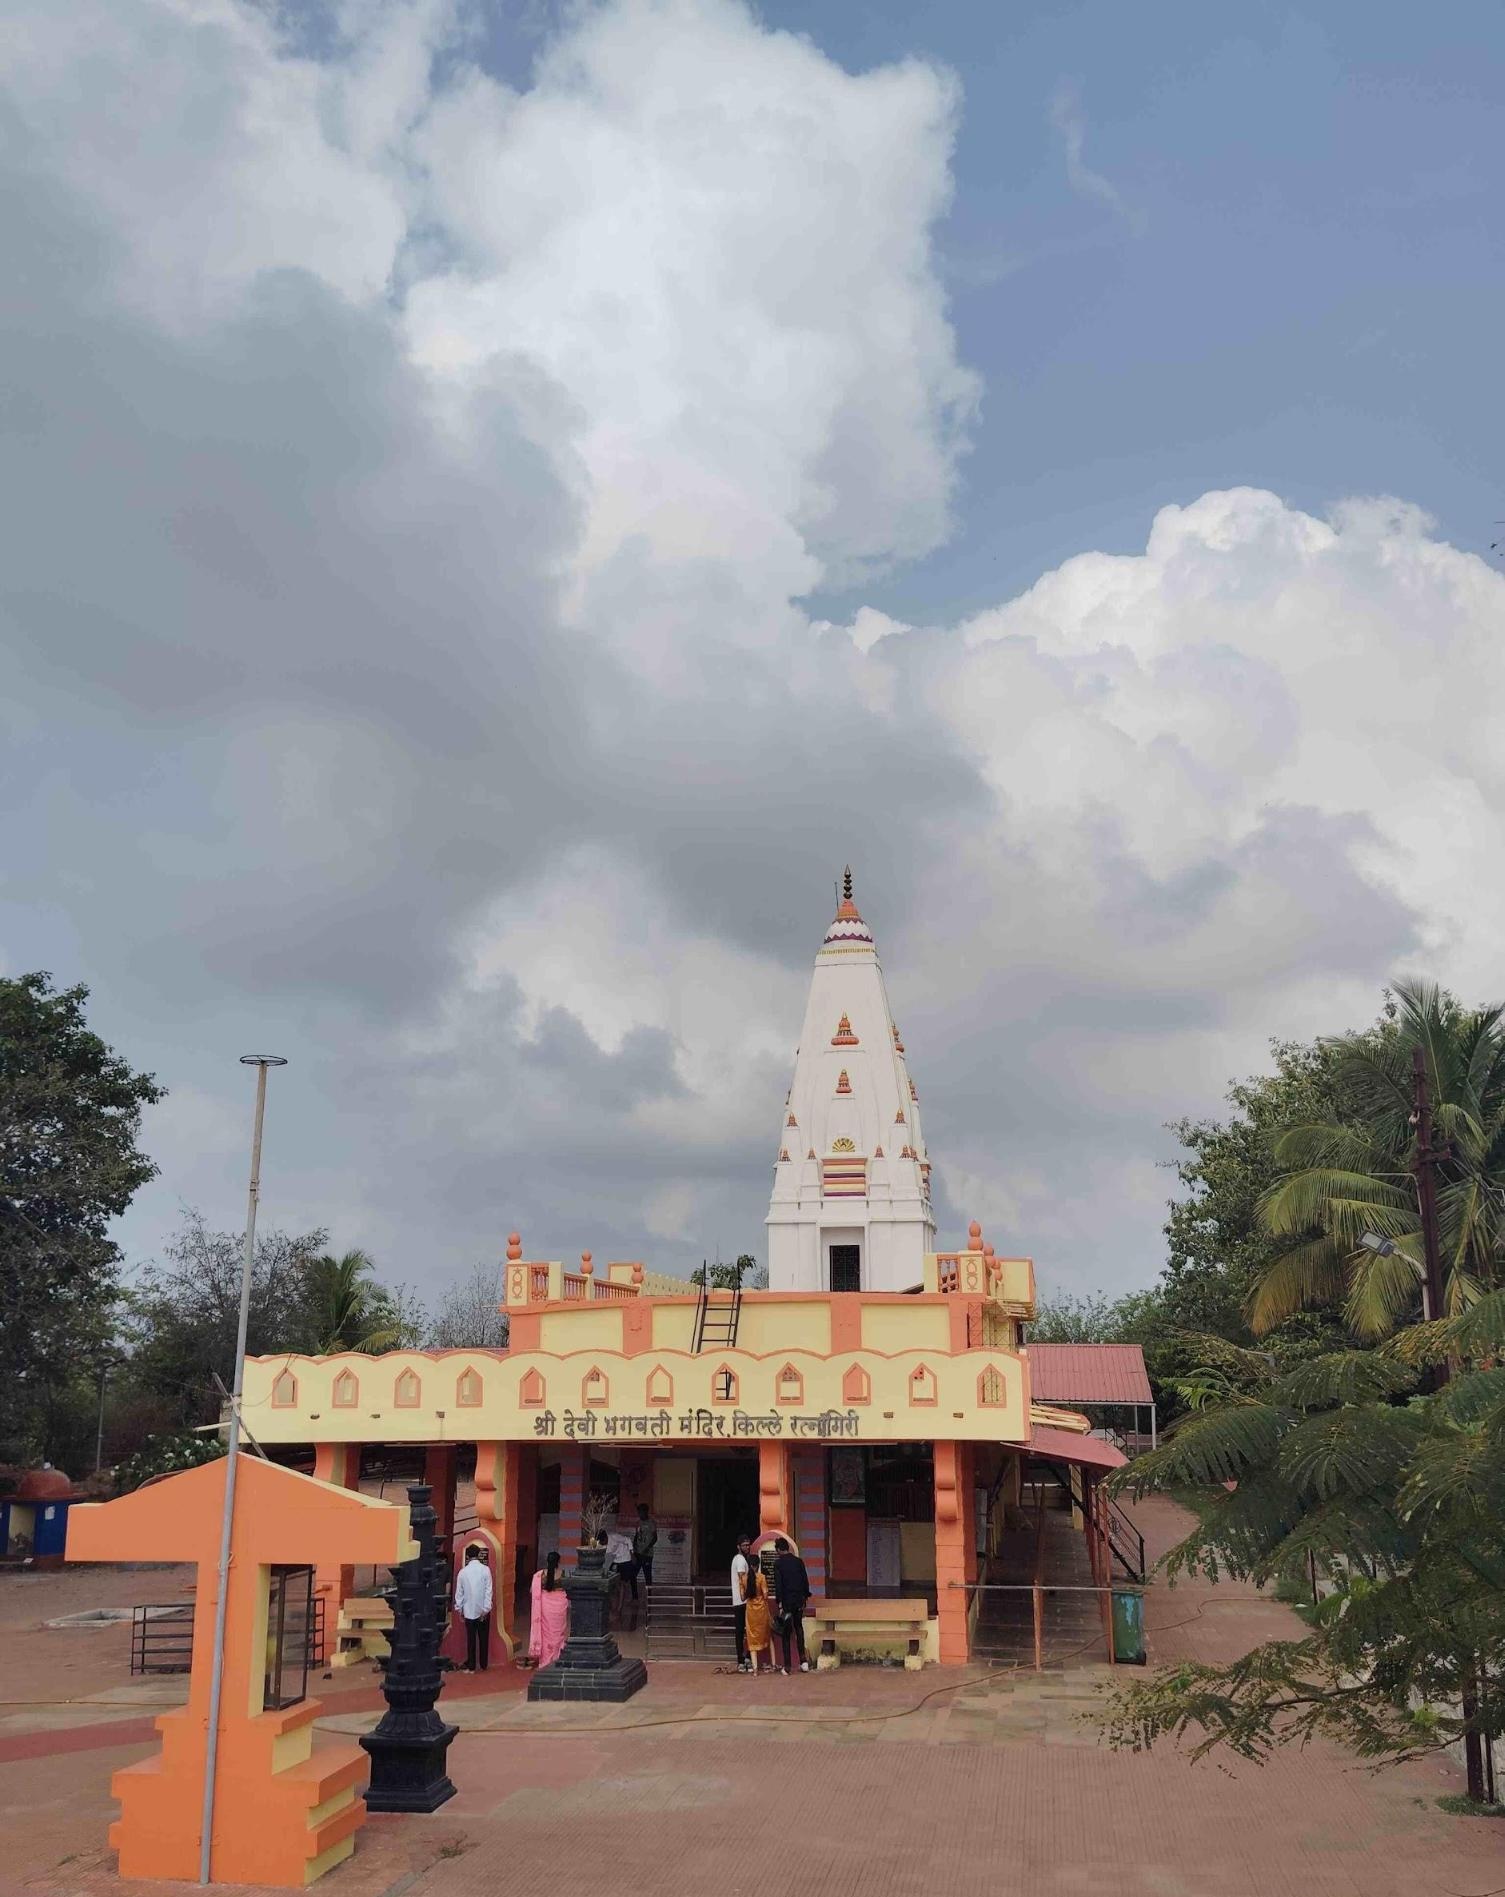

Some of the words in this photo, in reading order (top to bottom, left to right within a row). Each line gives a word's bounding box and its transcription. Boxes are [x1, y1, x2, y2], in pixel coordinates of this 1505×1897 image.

[534, 1409, 556, 1436] श्री
[563, 1409, 597, 1438] देवी
[604, 1409, 672, 1436] भगवती
[732, 1409, 783, 1437] किल्ले
